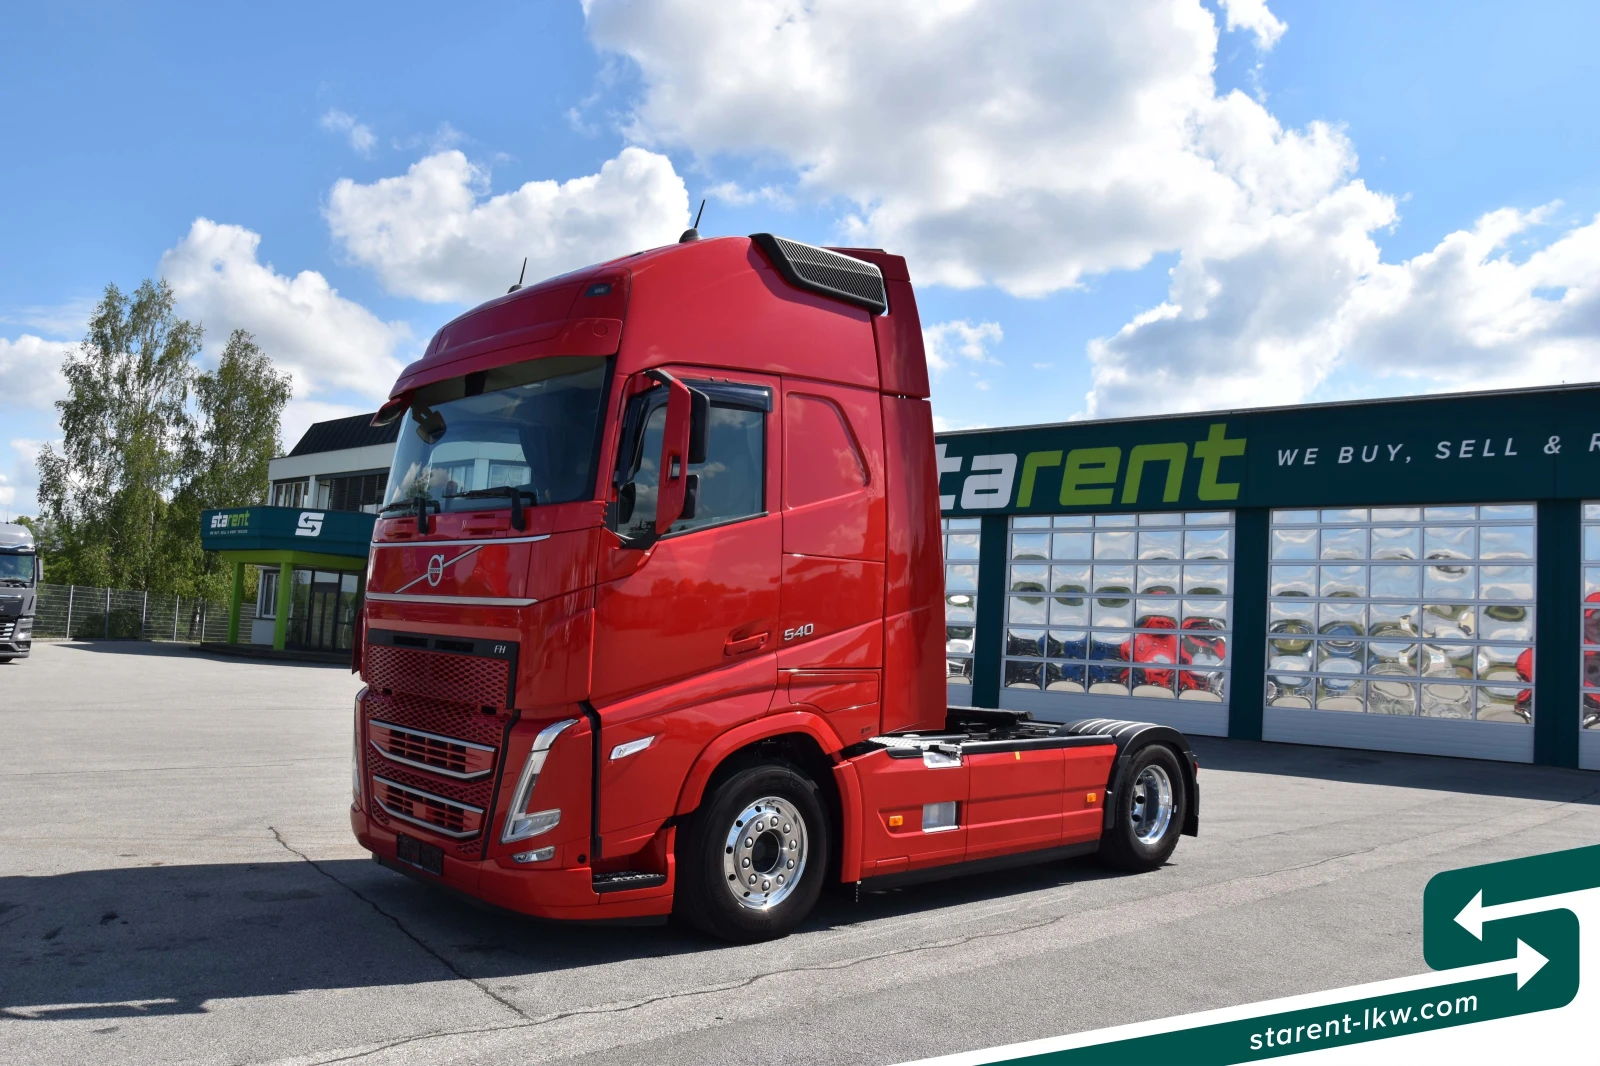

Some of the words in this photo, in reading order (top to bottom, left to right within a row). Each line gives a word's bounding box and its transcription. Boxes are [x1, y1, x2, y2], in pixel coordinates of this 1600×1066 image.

[1277, 448, 1318, 466] WE
[1337, 443, 1412, 464] BUY,
[1435, 437, 1518, 459] SELL
[1543, 435, 1562, 455] &
[210, 510, 250, 528] starent
[784, 623, 814, 641] 540
[494, 644, 506, 654] FH
